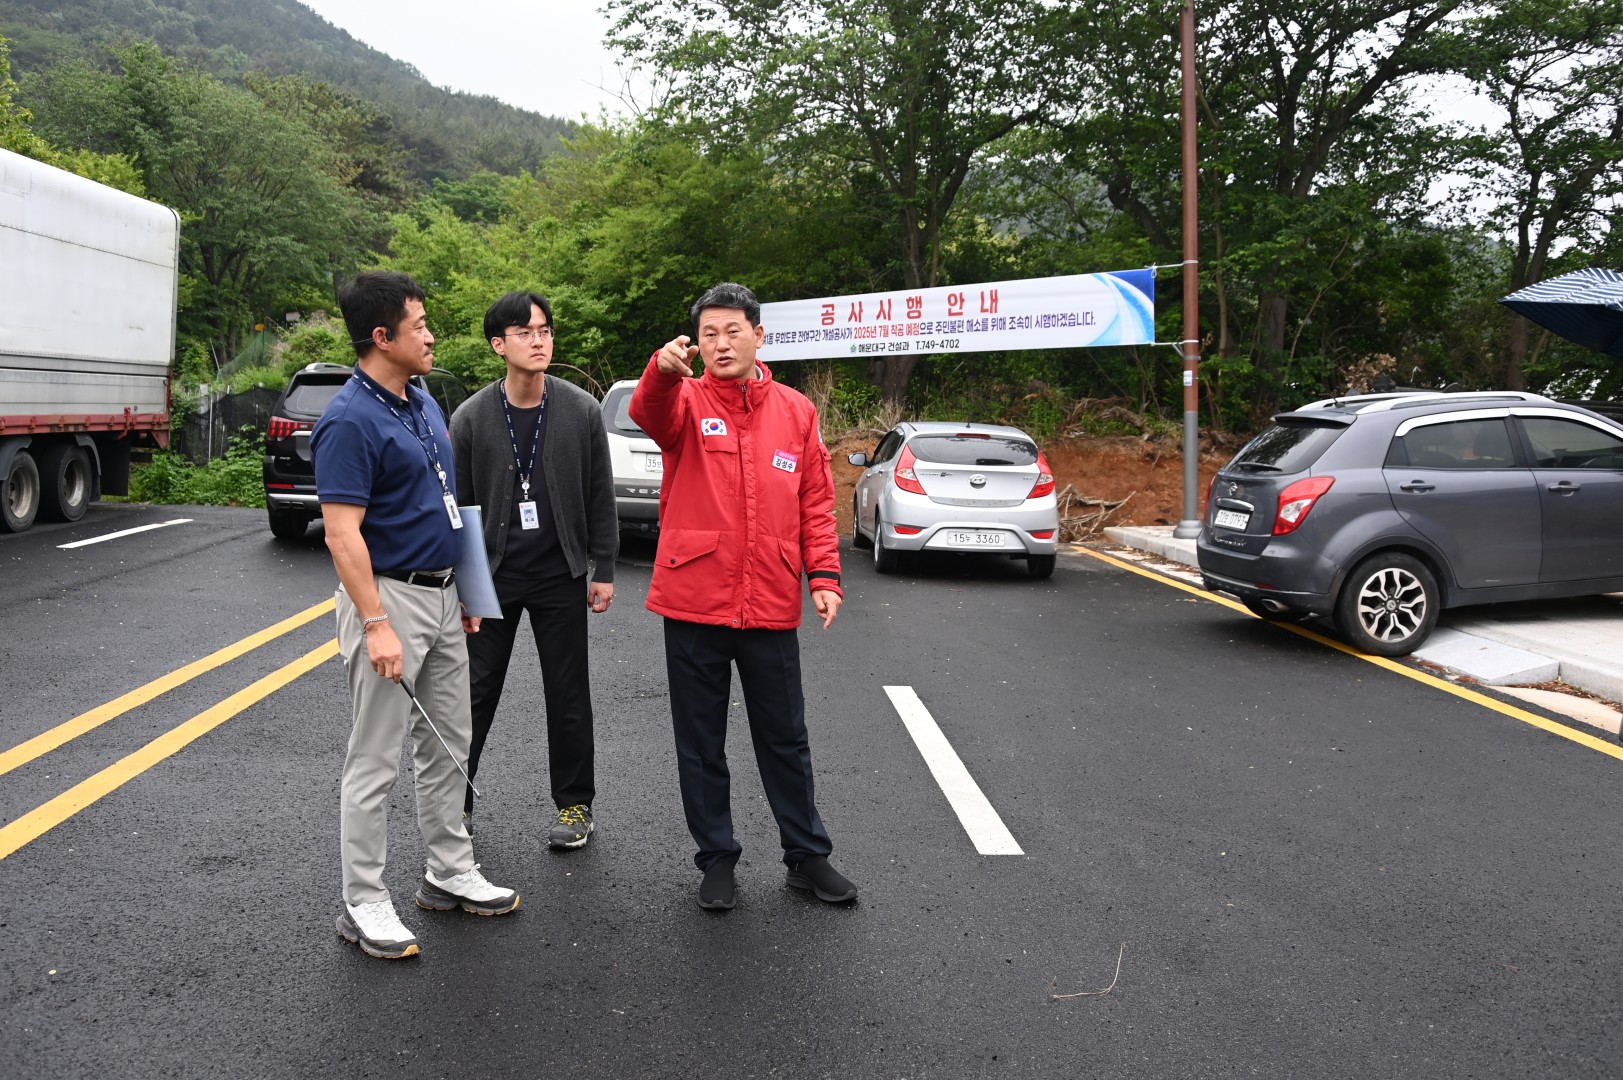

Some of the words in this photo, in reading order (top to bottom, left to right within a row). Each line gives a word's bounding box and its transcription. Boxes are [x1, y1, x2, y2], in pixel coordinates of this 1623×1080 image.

[775, 331, 797, 345] 우회도로
[797, 329, 821, 343] 잔여구간
[822, 327, 853, 341] 개설공사가
[854, 326, 877, 339] 2025년
[878, 325, 889, 338] 7월
[890, 324, 904, 337] 착공
[906, 321, 934, 336] 예정으로
[935, 318, 965, 334] 주민불편
[966, 317, 989, 332] 해소를
[991, 316, 1007, 331] 위해
[1008, 314, 1033, 330] 조속히
[1034, 311, 1096, 329] 시행하겠습니다.
[858, 342, 886, 353] 해운대구
[887, 341, 910, 352] 건설과
[915, 339, 960, 350] T.749-4702
[776, 458, 793, 470] 김성수
[953, 533, 971, 543] 15누
[975, 534, 1000, 544] 3360
